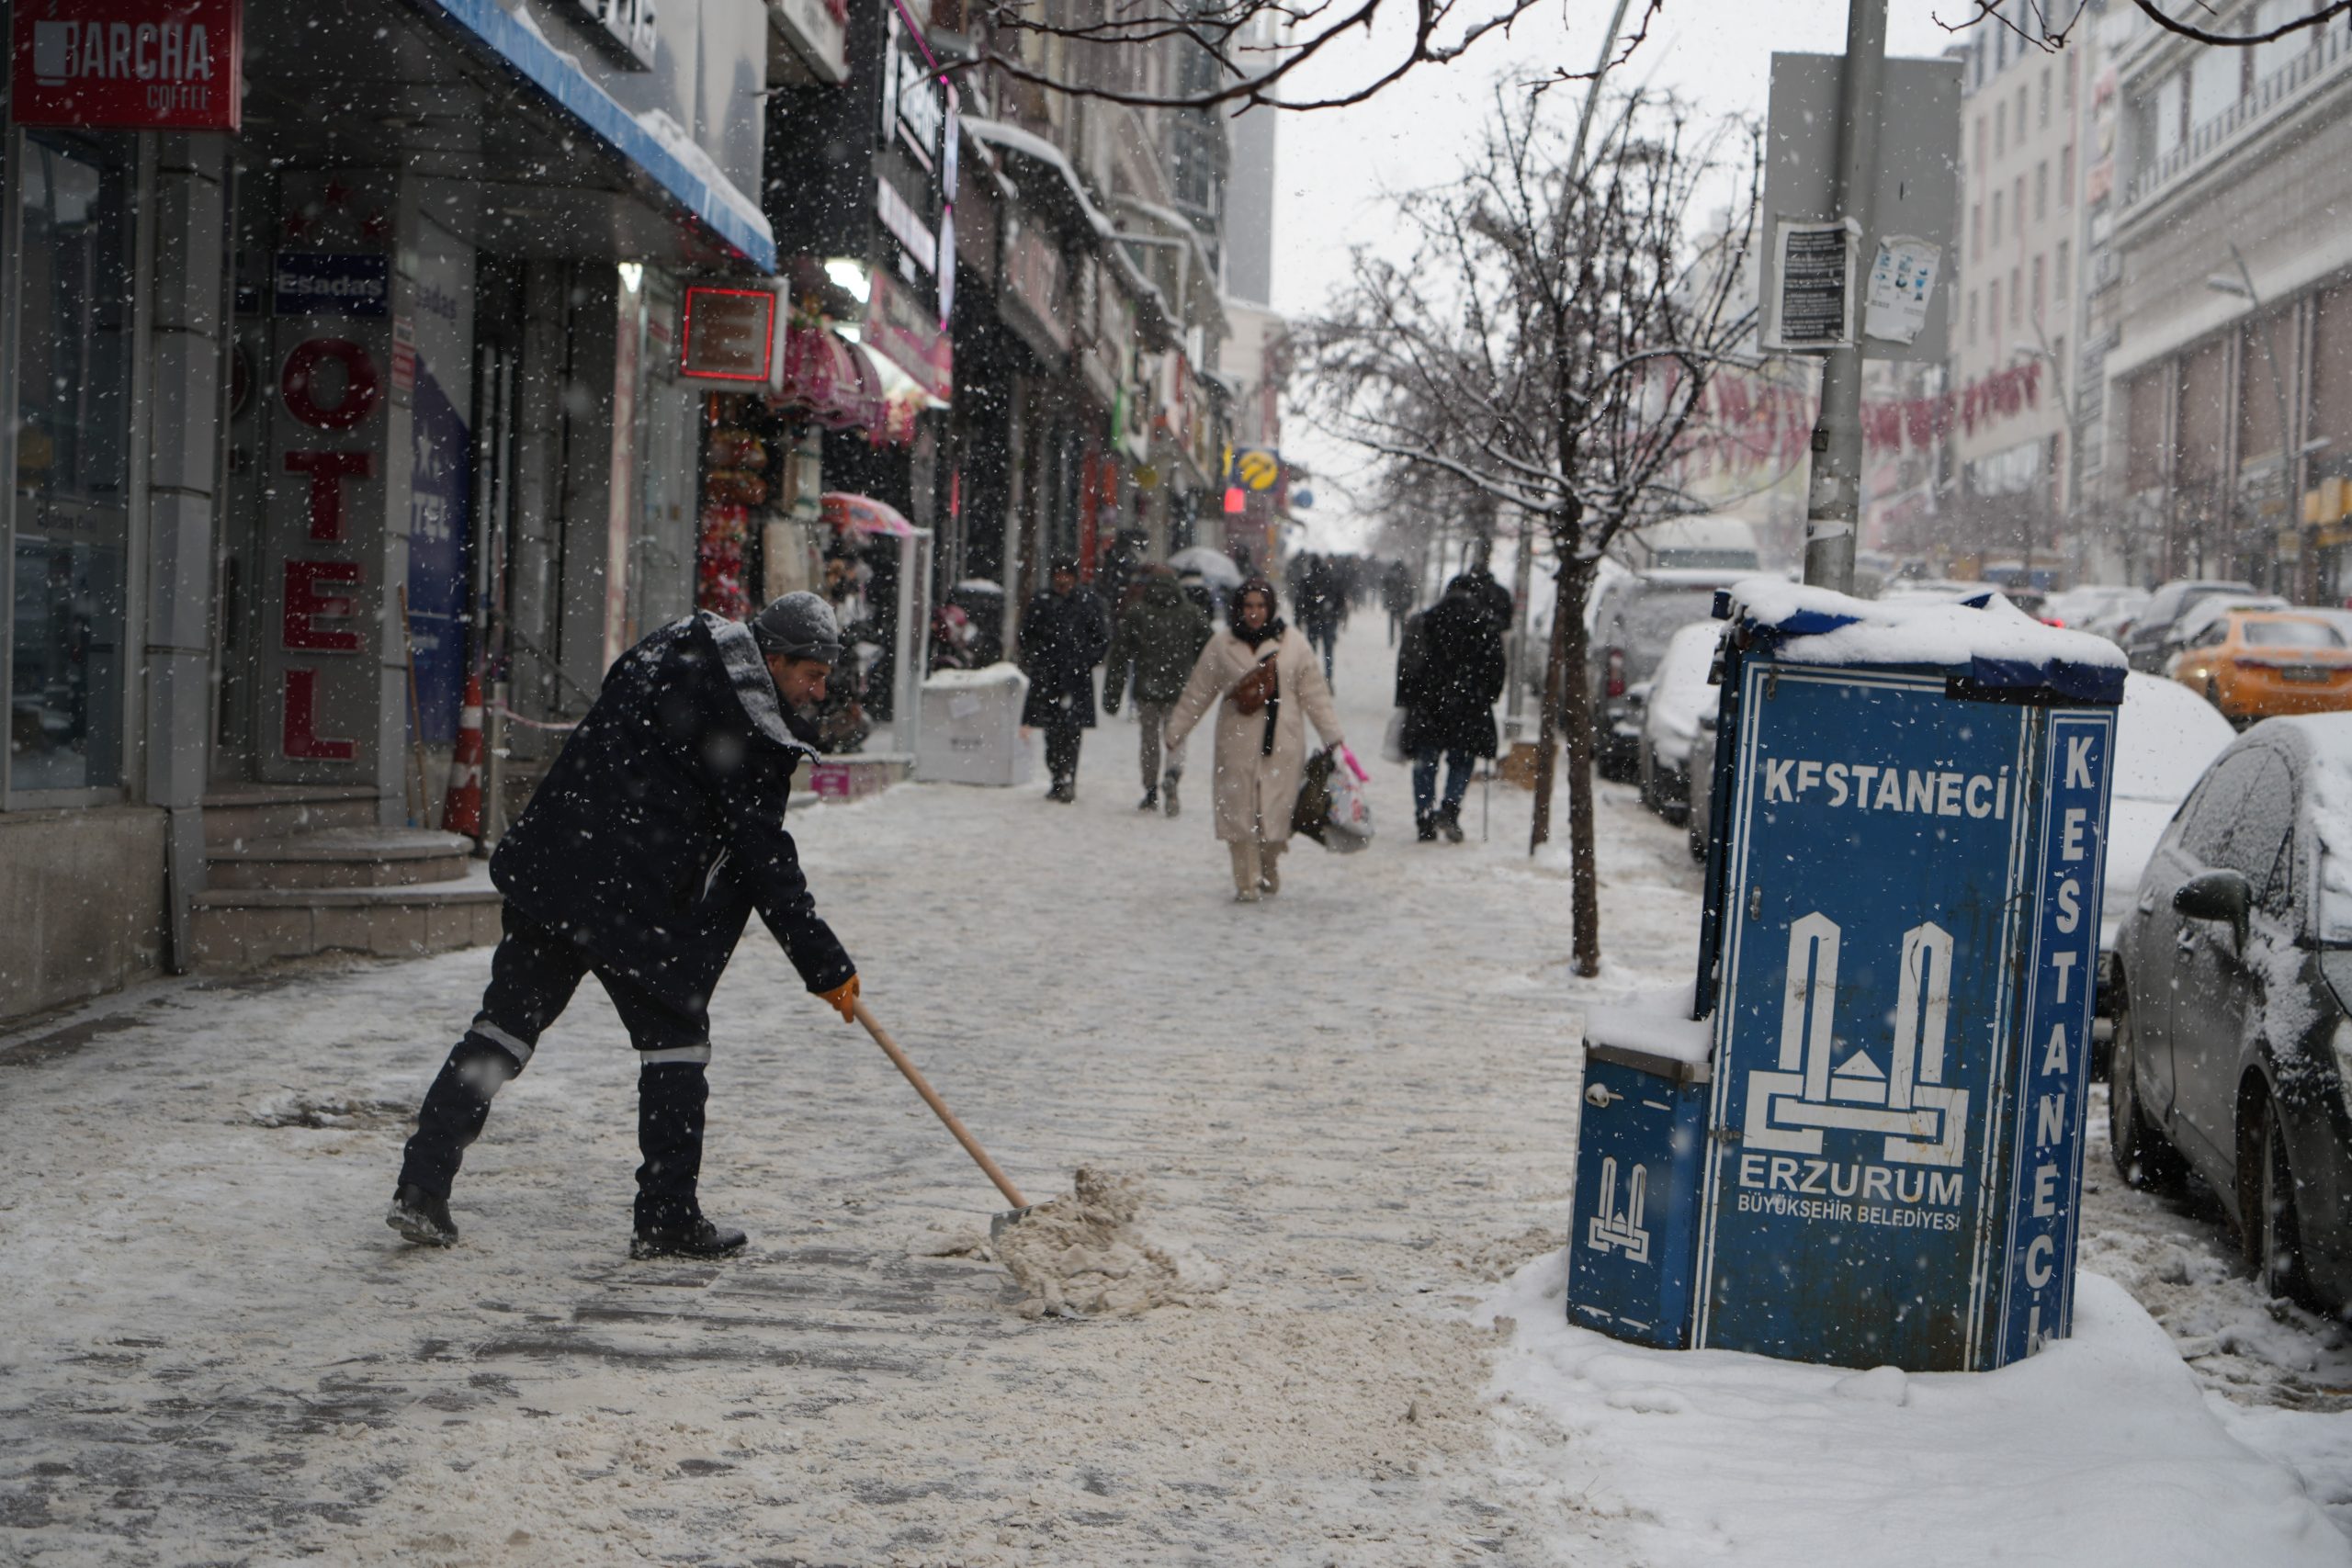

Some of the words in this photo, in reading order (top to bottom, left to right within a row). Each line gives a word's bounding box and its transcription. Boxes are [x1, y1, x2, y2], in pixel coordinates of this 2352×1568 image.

[34, 20, 210, 81] BARCHA
[146, 85, 209, 110] COFFEE
[281, 337, 380, 761] OTEL
[2027, 736, 2094, 1358] KESTANECİ
[1739, 1154, 1963, 1207] ERZURUM
